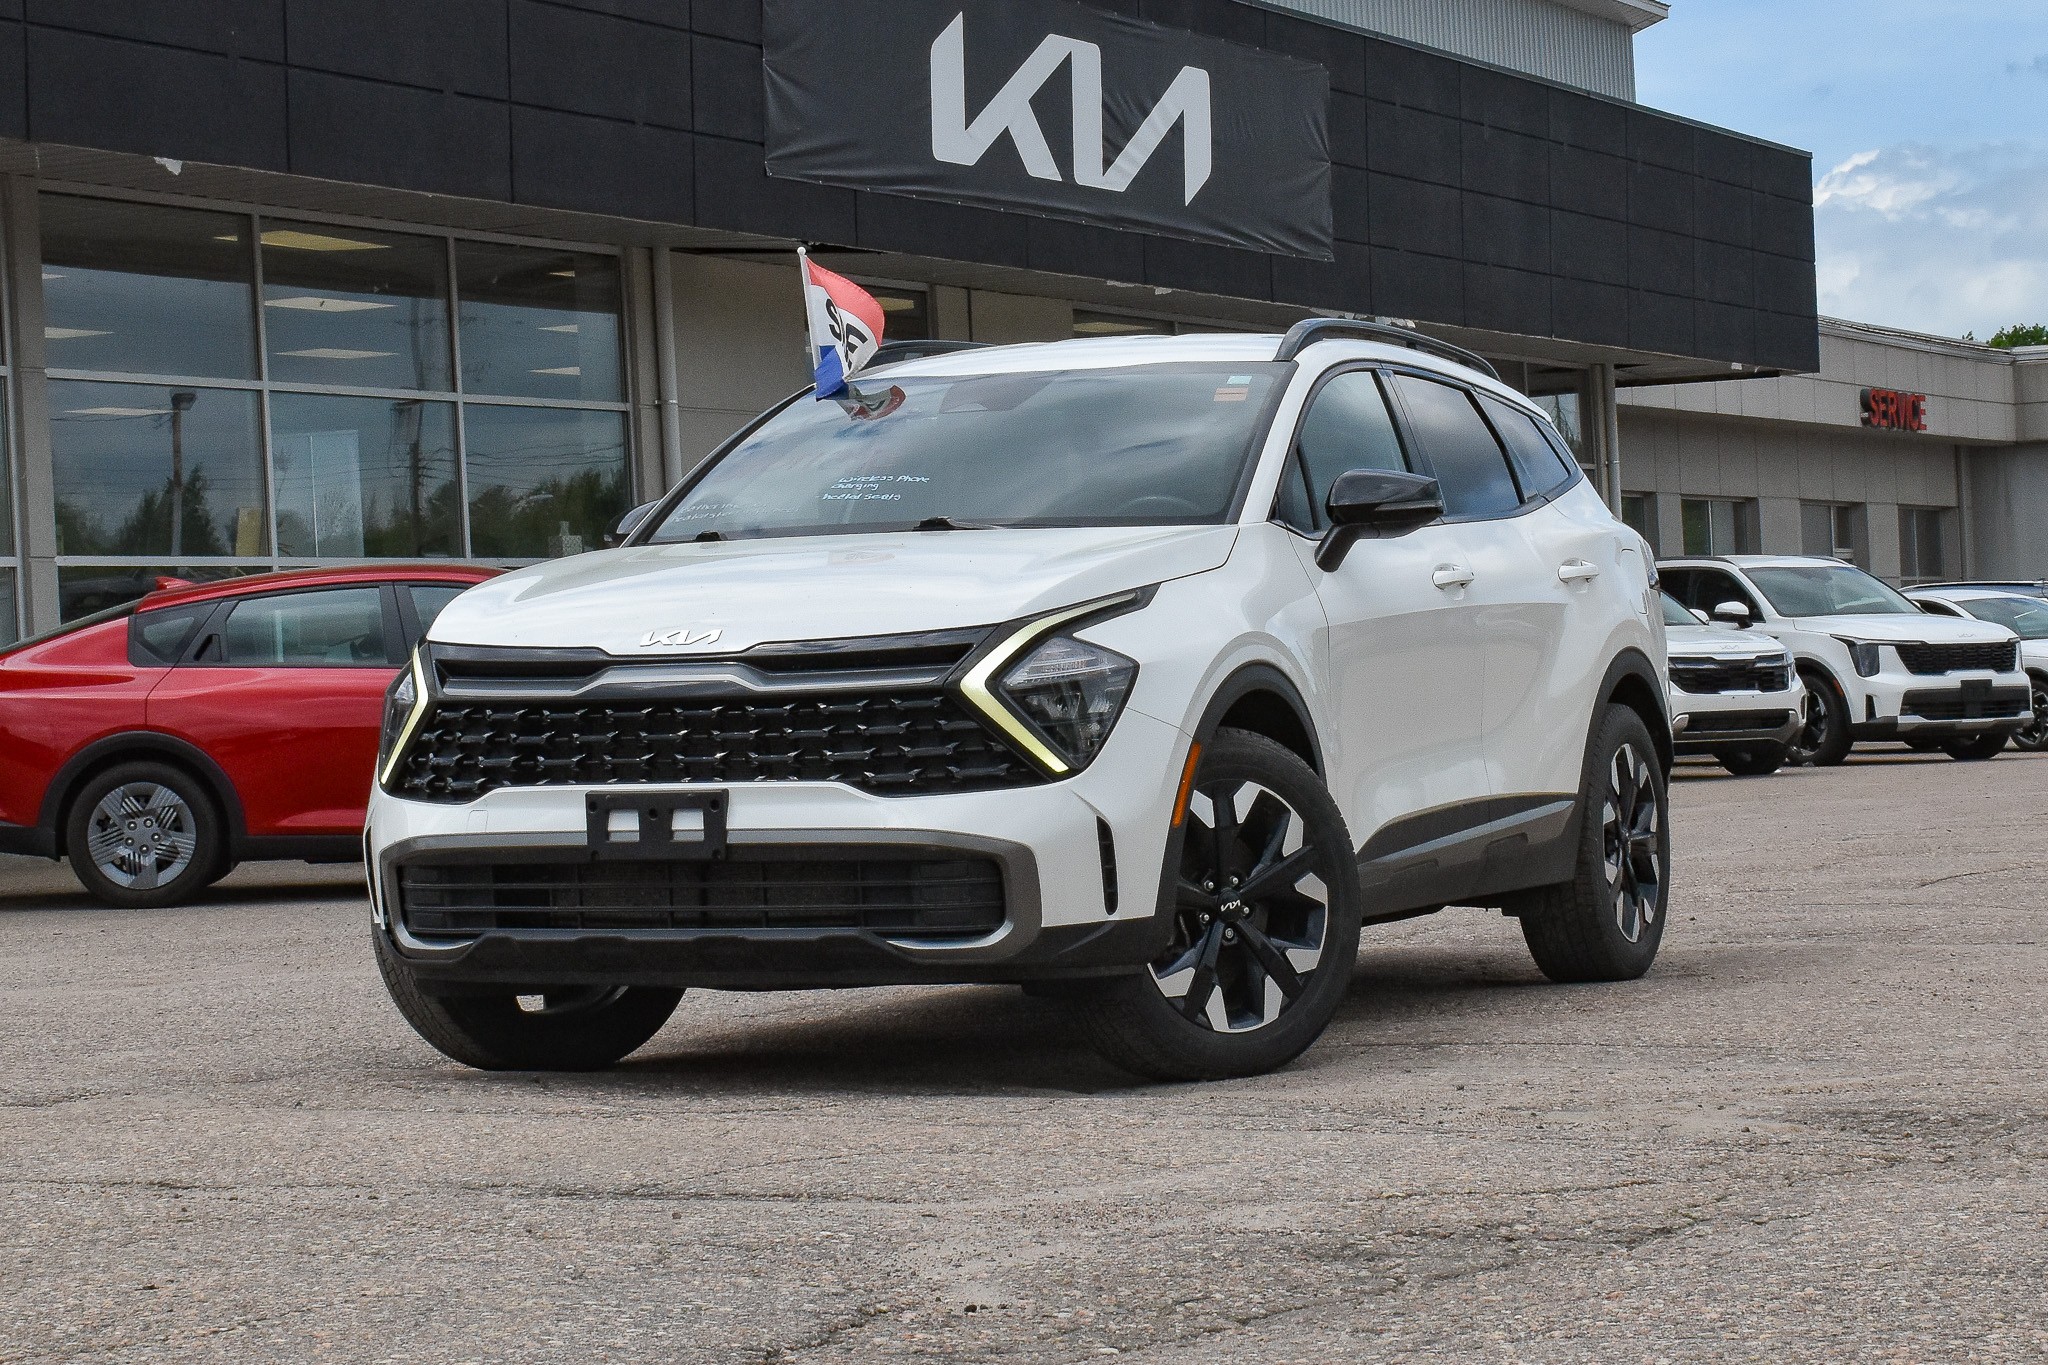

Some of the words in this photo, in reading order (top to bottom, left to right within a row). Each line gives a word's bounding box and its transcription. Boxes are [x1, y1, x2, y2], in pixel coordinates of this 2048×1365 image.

[930, 11, 1212, 207] KIA
[1860, 387, 1927, 430] SERVICE
[640, 629, 723, 647] KIA
